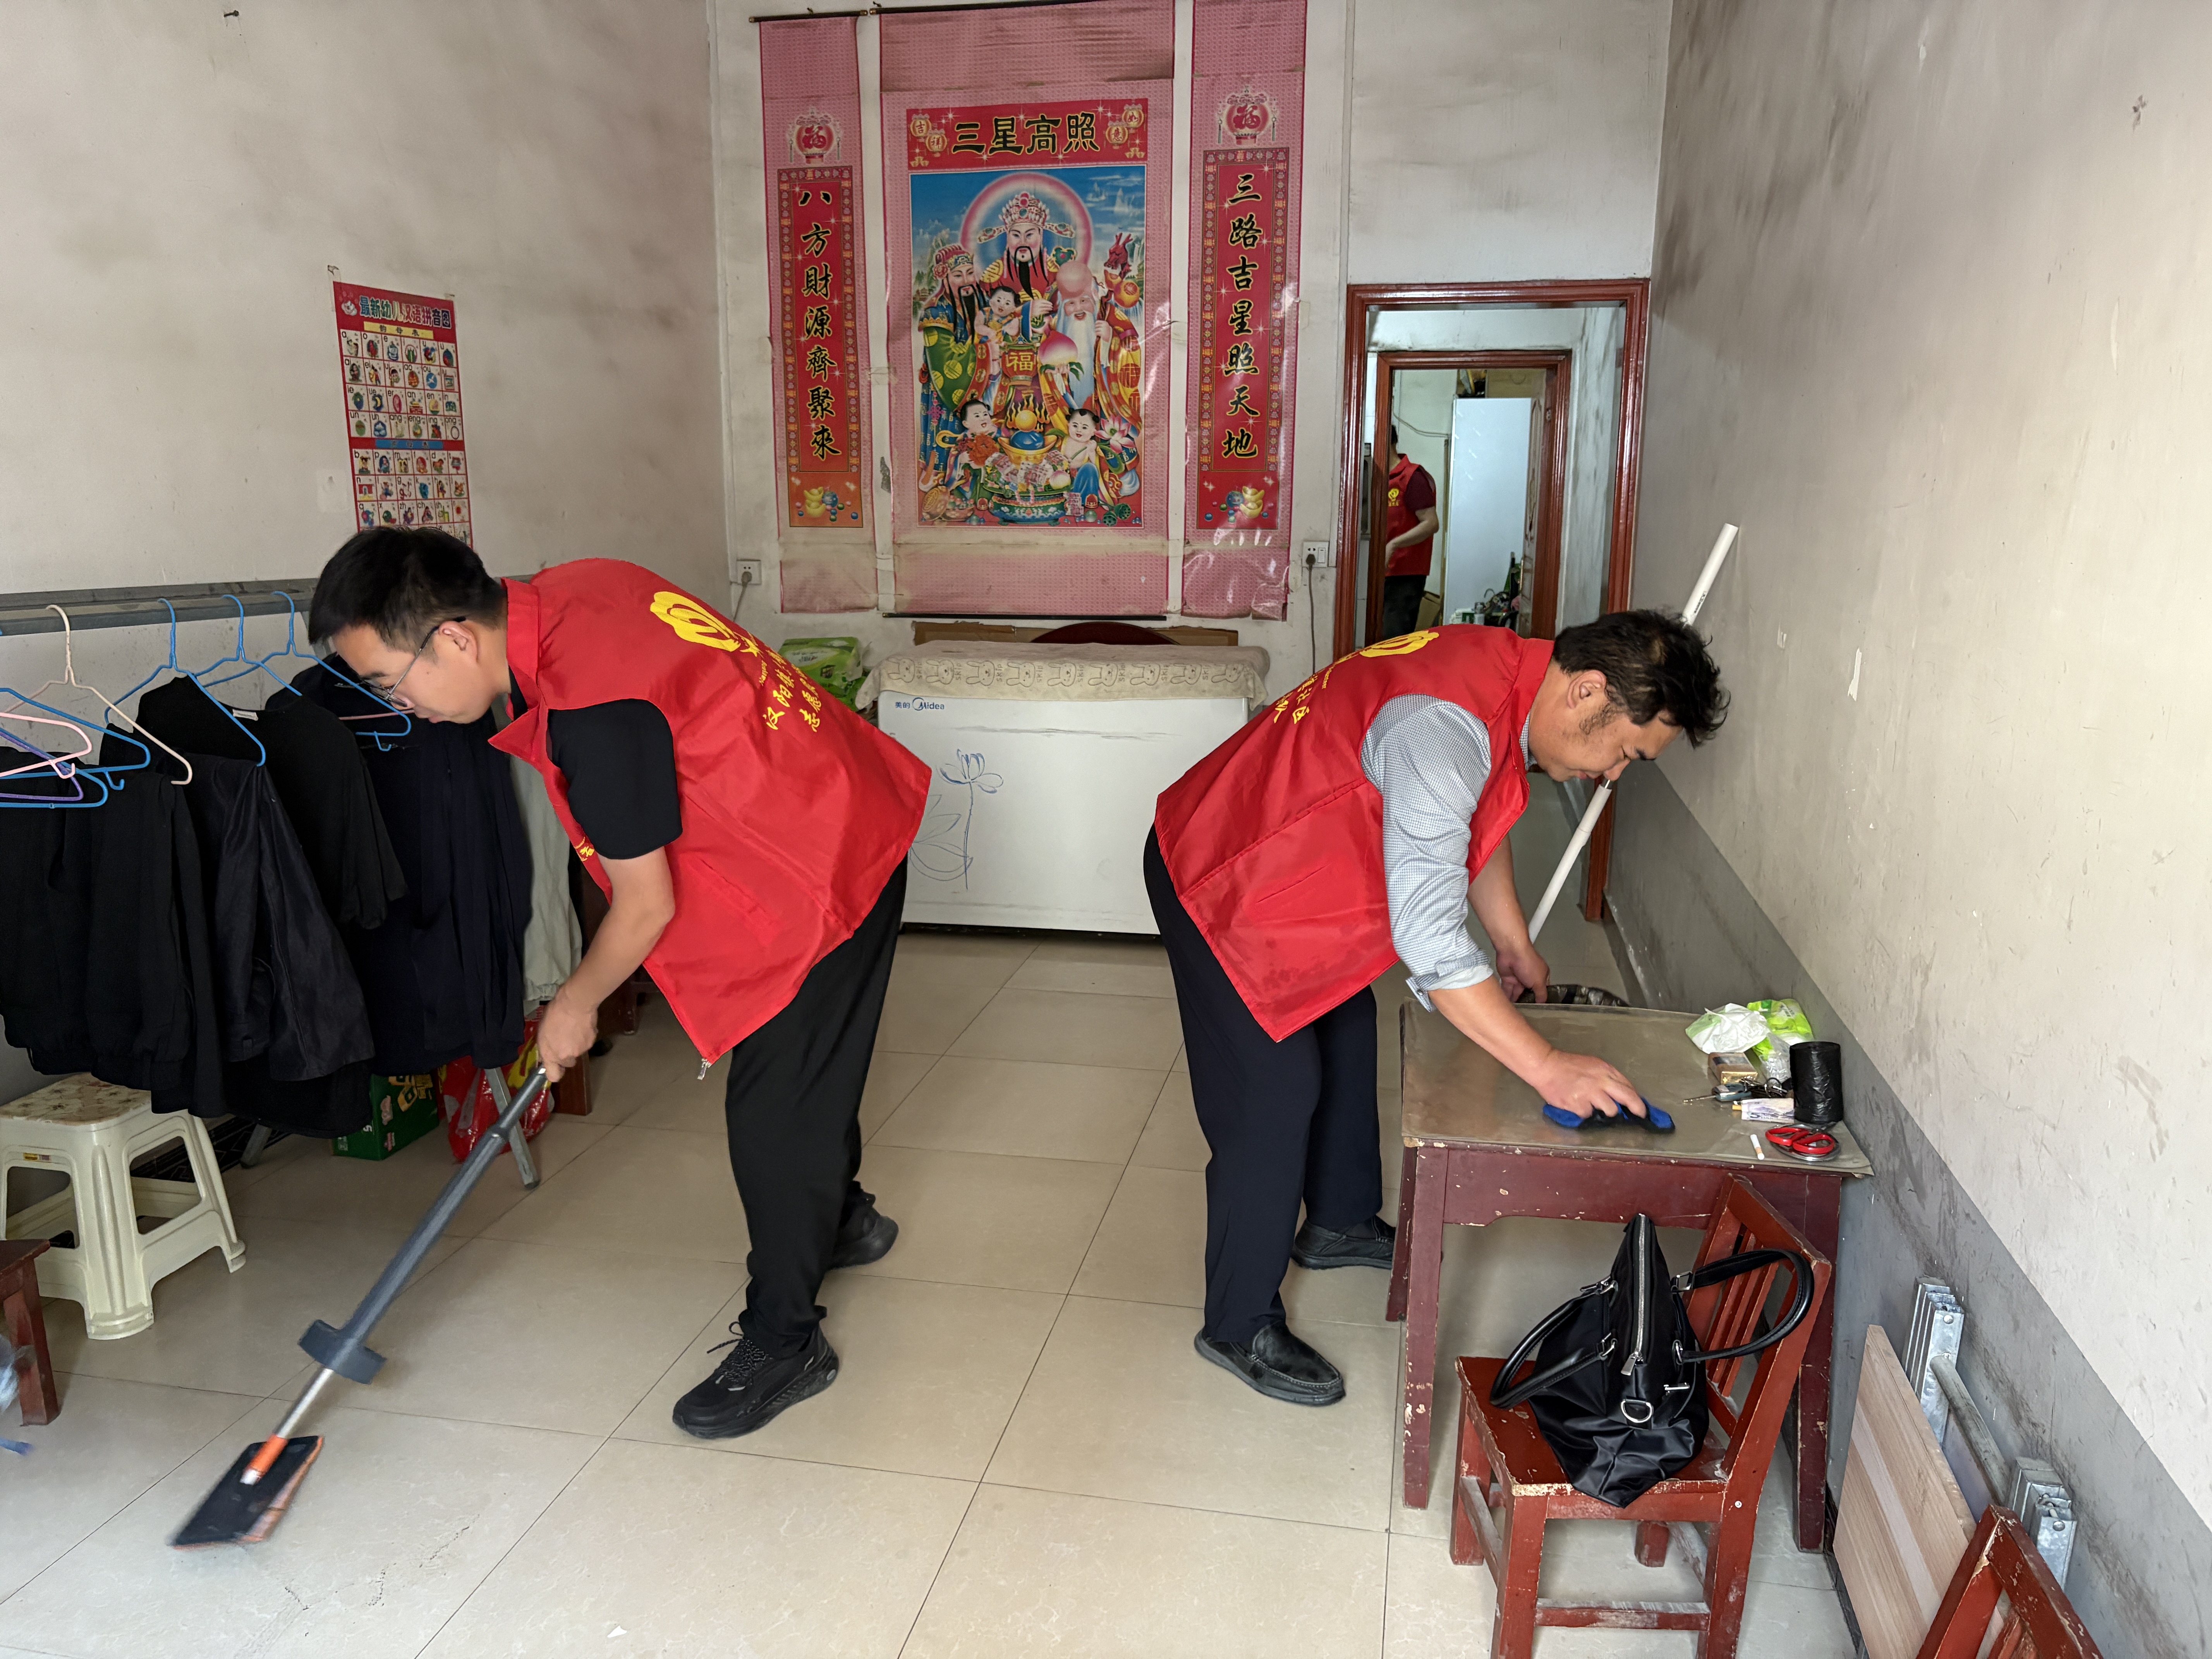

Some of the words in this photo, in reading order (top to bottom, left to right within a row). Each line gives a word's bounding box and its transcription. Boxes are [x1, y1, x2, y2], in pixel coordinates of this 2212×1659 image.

[952, 112, 1100, 155] 三星高照
[1221, 173, 1264, 459] 三路吉星照天地
[1007, 352, 1034, 372] 福
[915, 699, 945, 710] Midea
